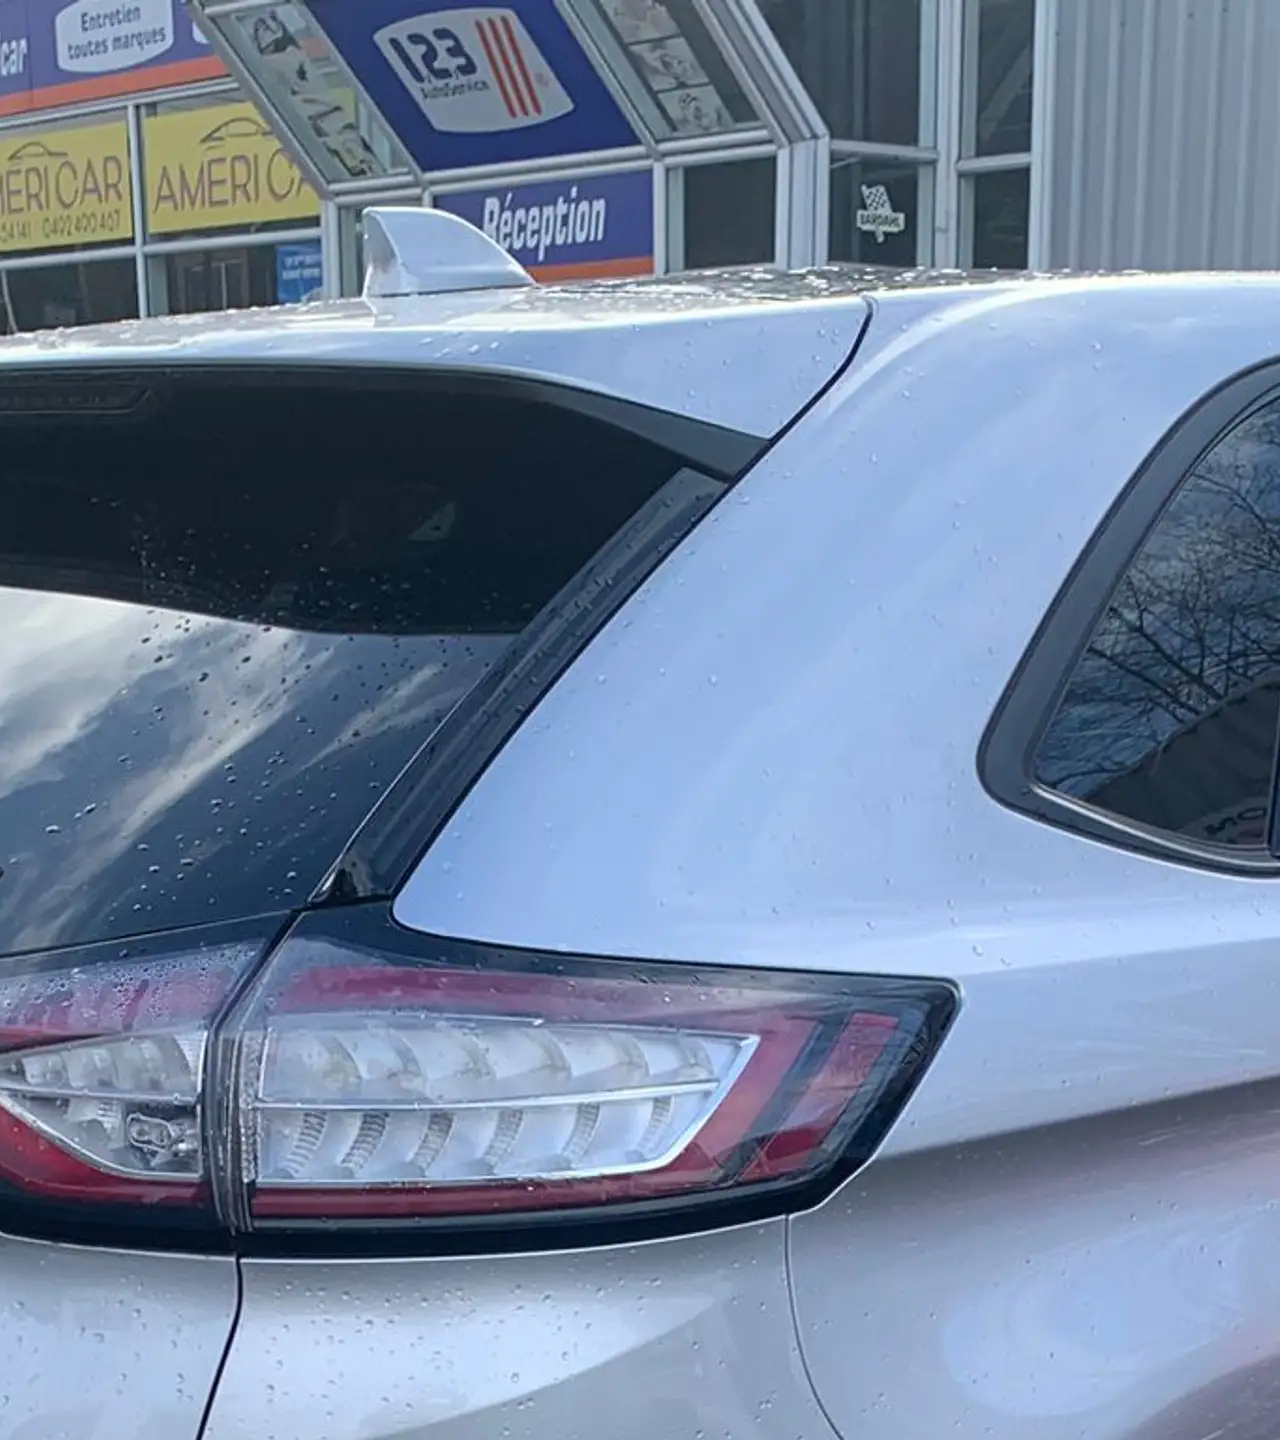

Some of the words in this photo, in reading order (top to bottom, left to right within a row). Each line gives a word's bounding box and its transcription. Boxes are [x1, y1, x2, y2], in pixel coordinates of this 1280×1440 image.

[80, 4, 141, 32] Entretien
[67, 37, 108, 60] toutes
[111, 26, 166, 52] marques
[483, 183, 606, 261] Réception
